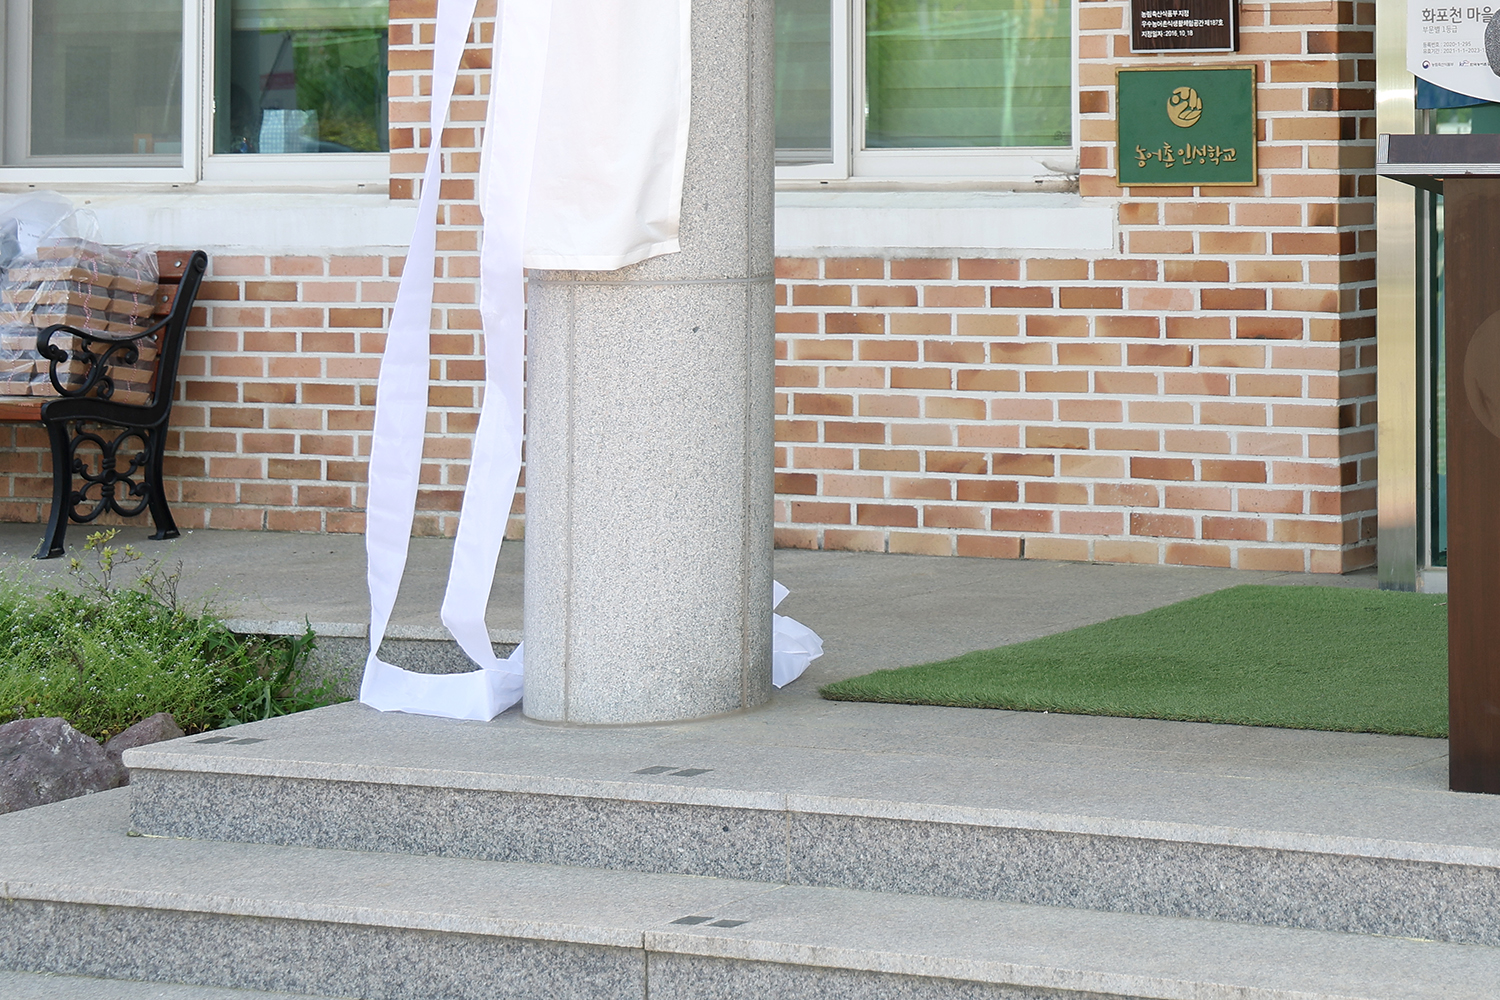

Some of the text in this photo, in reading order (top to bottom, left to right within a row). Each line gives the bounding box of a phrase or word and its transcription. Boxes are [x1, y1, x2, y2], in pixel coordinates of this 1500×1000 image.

[1422, 6, 1493, 23] 화포천 마을
[1134, 142, 1237, 168] 농어촌 인성학교
